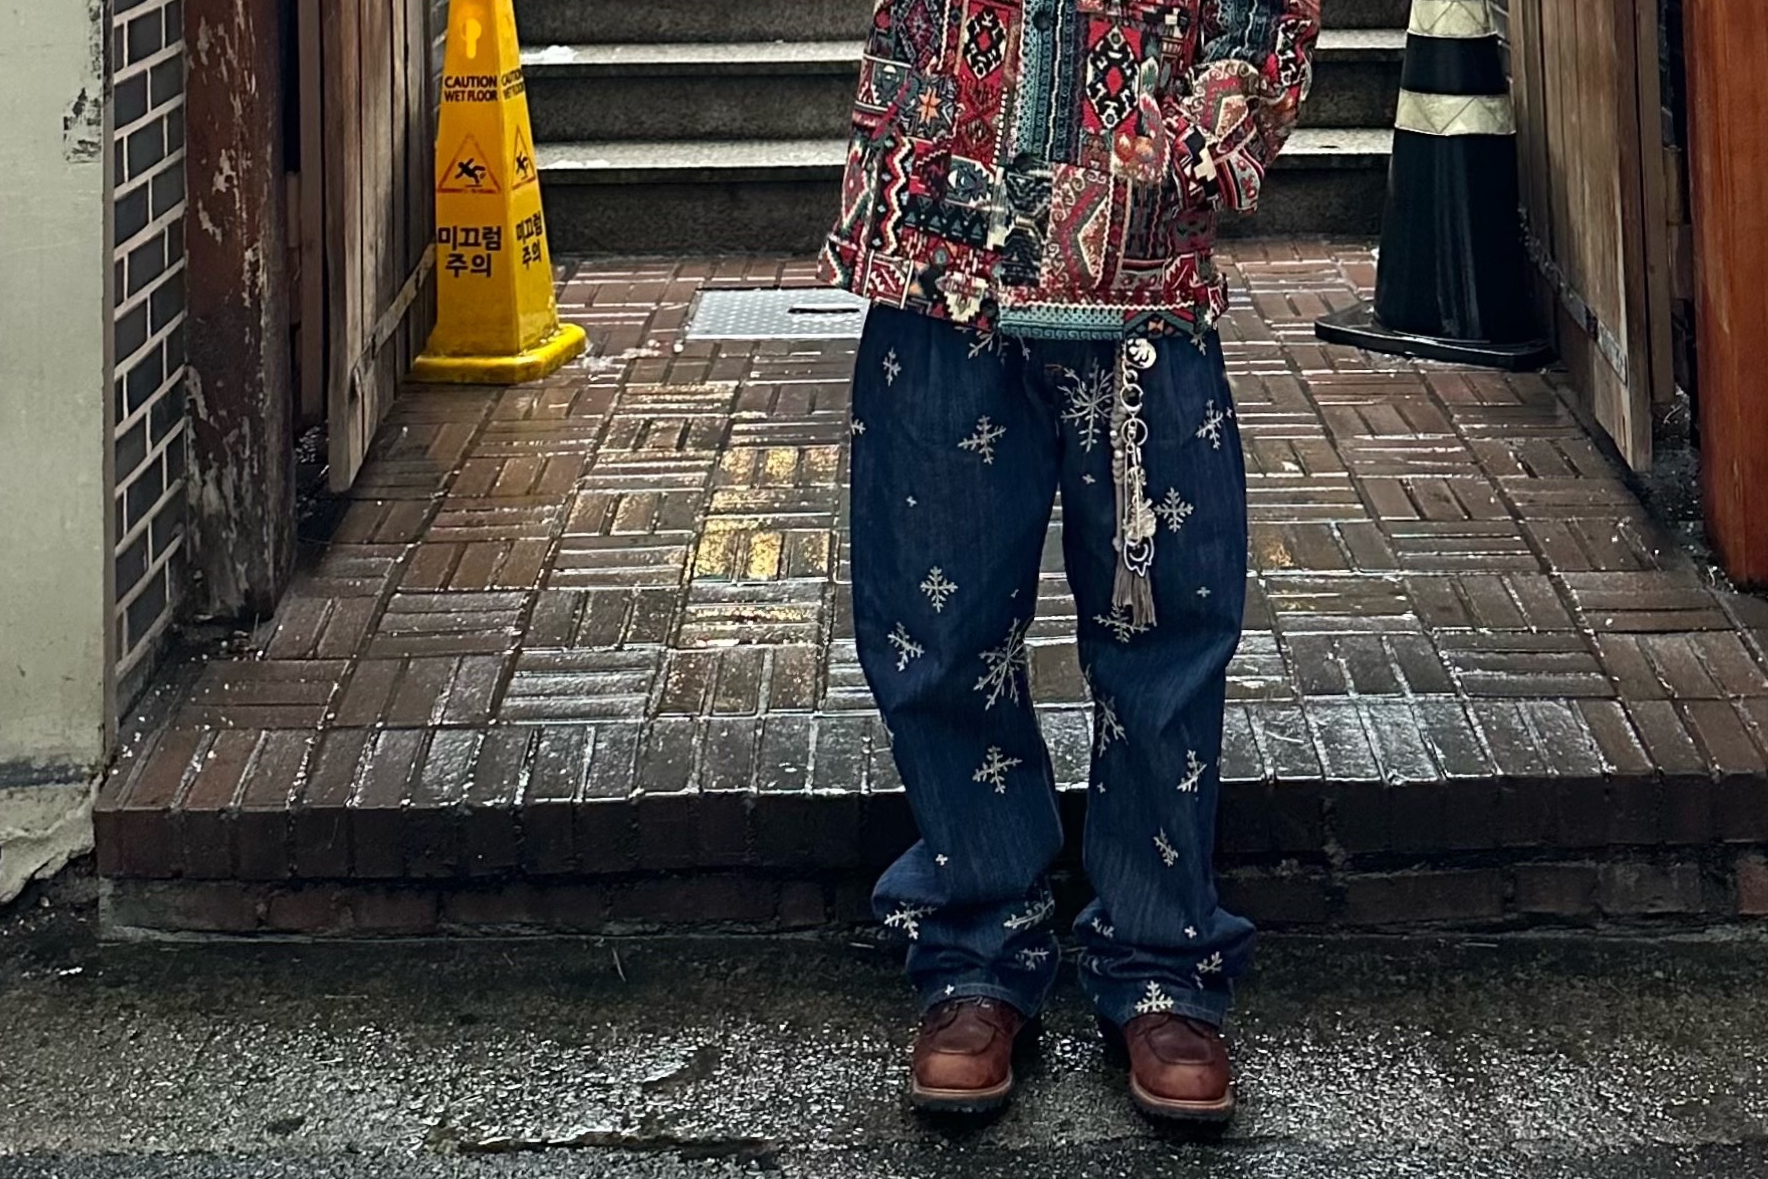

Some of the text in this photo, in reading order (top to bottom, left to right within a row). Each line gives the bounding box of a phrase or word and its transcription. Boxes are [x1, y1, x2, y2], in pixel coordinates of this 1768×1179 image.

[444, 75, 498, 88] CAUTION
[444, 91, 498, 102] WET FLOOR
[438, 226, 502, 251] 미끄럼
[516, 210, 543, 244] 미끄럼
[445, 253, 491, 278] 주의
[522, 239, 542, 271] 주의
